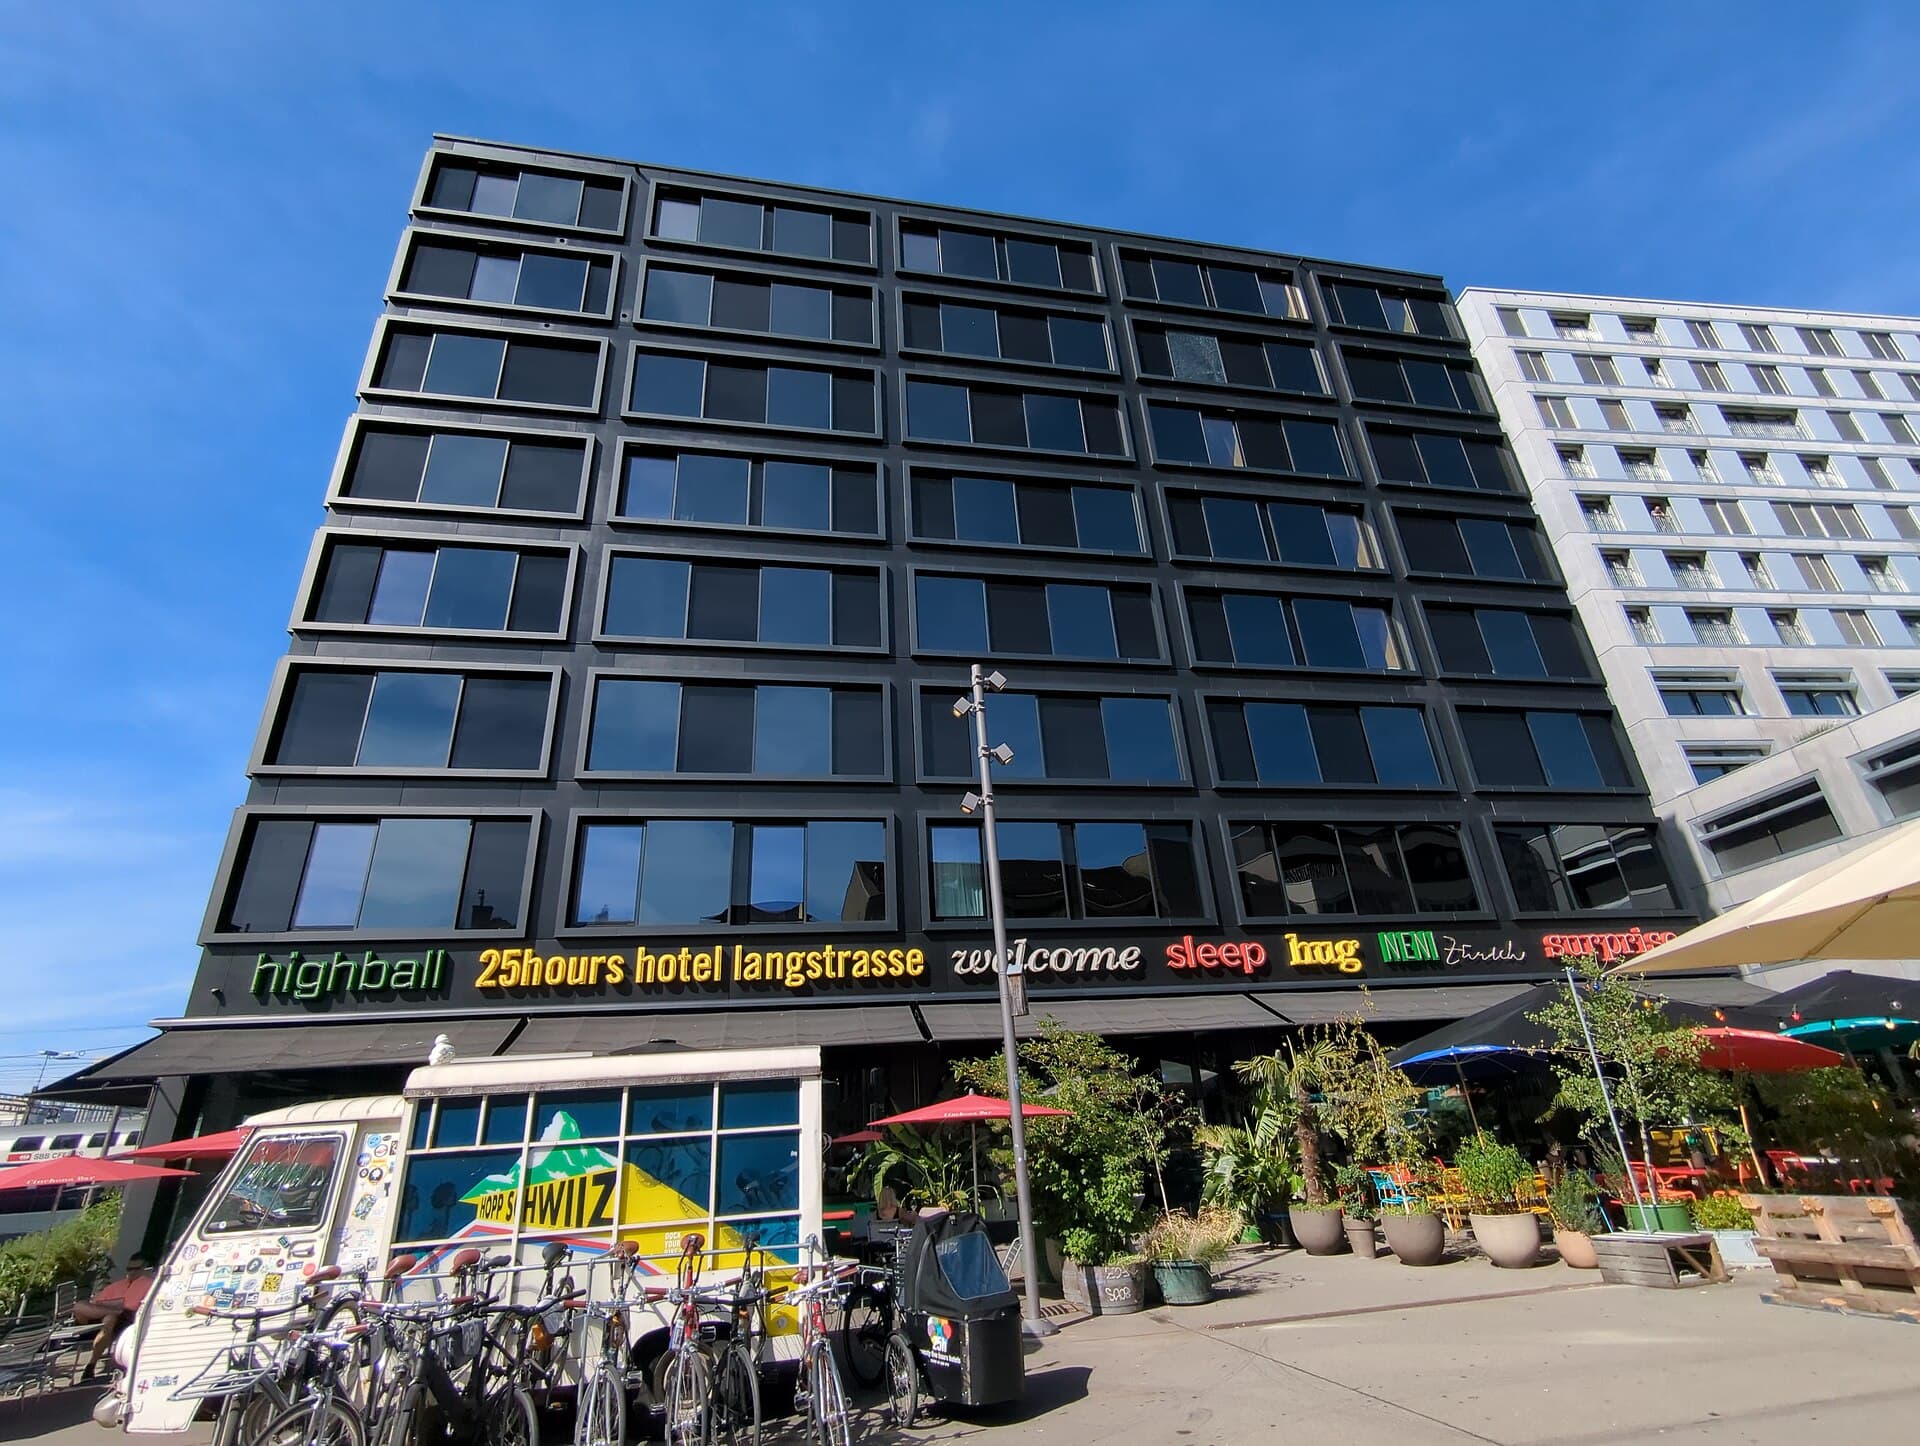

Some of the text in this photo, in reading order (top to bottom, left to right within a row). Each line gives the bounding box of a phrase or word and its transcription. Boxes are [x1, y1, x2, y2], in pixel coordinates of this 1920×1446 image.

[475, 943, 925, 988] 25hours hotel langstrasse
[1166, 935, 1266, 975] sleep
[1284, 932, 1363, 973] hug
[1378, 930, 1441, 963] NENI
[249, 949, 449, 1000] highball
[479, 1194, 503, 1220] HOPP
